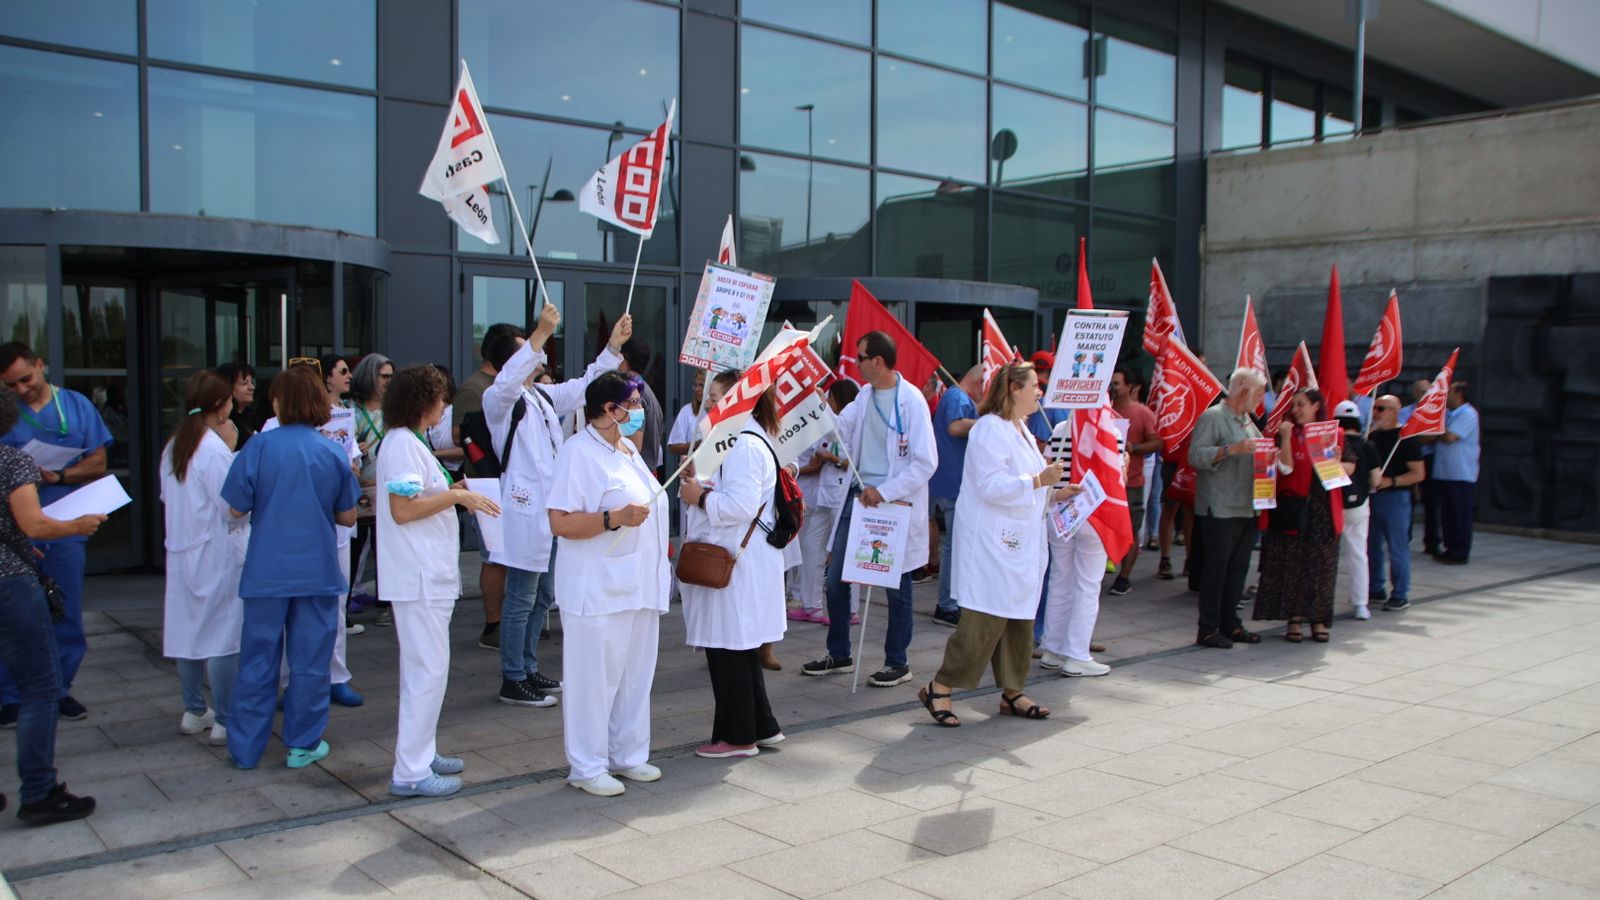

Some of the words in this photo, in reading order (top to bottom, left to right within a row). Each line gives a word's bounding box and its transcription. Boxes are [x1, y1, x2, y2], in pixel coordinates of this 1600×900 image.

[465, 194, 488, 225] León
[1074, 321, 1107, 330] CONTRA
[1108, 322, 1120, 331] UN
[1075, 332, 1114, 341] ESTATUTO
[1077, 342, 1107, 351] MARCO
[1056, 379, 1104, 391] INSUFICIENTE
